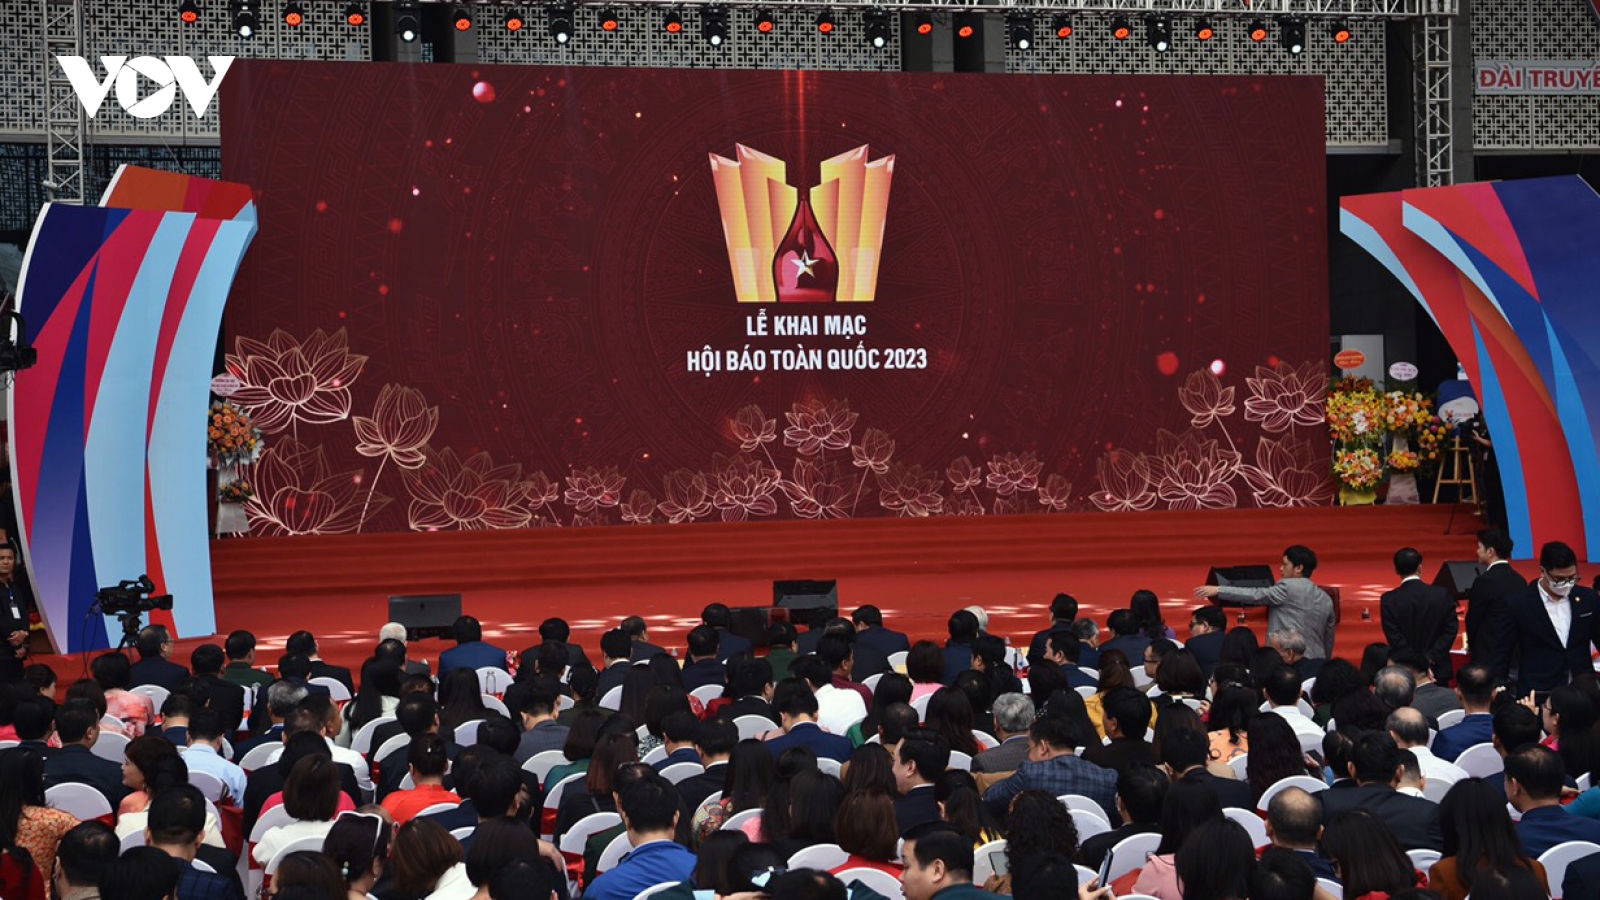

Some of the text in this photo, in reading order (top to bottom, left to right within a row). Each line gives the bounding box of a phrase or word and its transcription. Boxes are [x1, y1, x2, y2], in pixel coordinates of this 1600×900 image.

[1480, 65, 1522, 88] ĐÀI
[746, 308, 867, 340] LỄ KHAI MẠC
[686, 340, 928, 378] HỘI BÁO TOÀN QUỐC 2023
